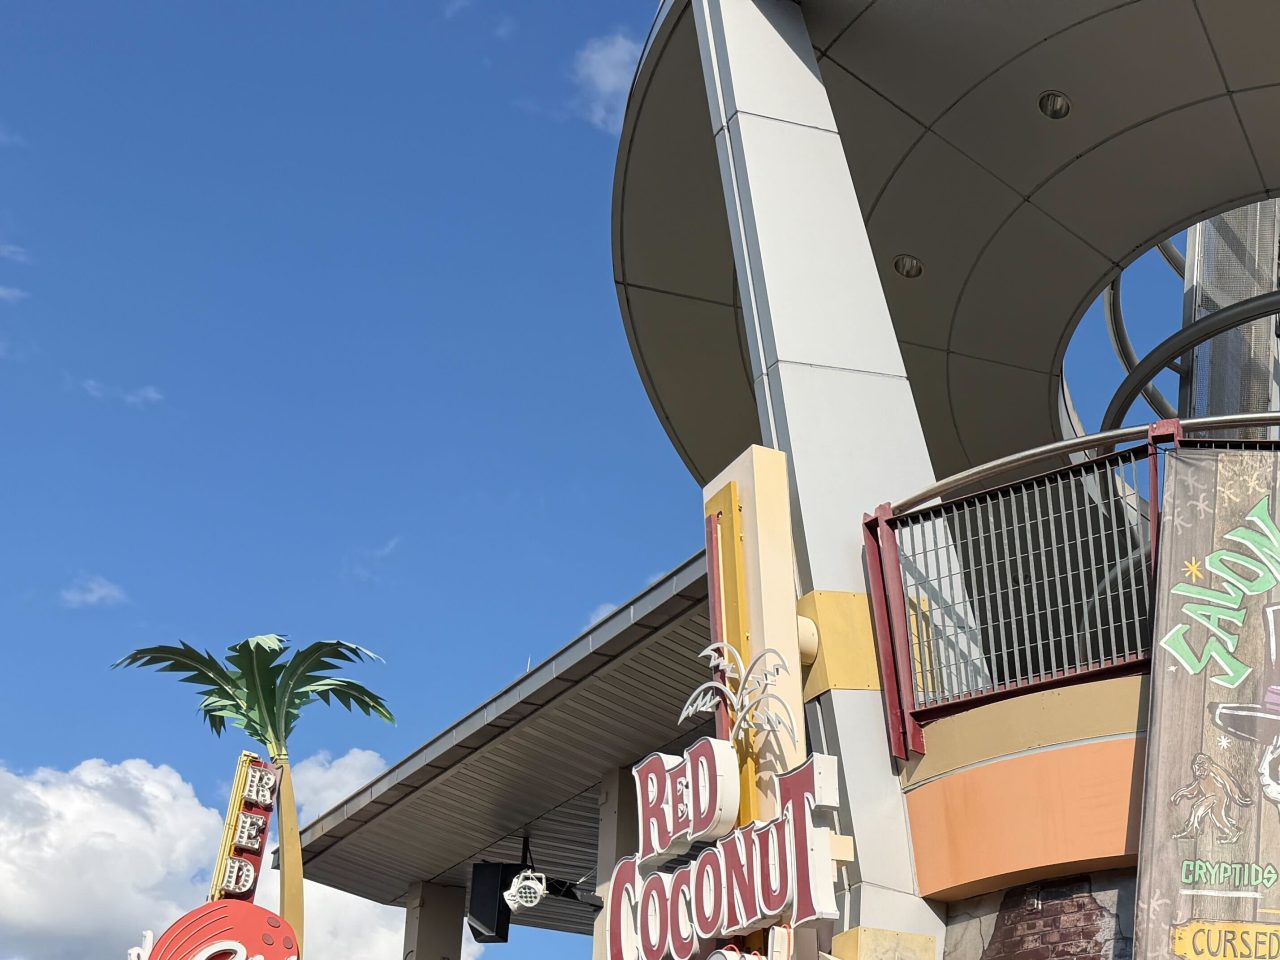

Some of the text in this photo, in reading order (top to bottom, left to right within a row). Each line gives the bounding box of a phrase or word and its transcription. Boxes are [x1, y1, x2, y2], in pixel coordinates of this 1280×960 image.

[222, 766, 277, 895] RED
[633, 736, 732, 861] RED
[1180, 859, 1279, 888] CRYPTIDS
